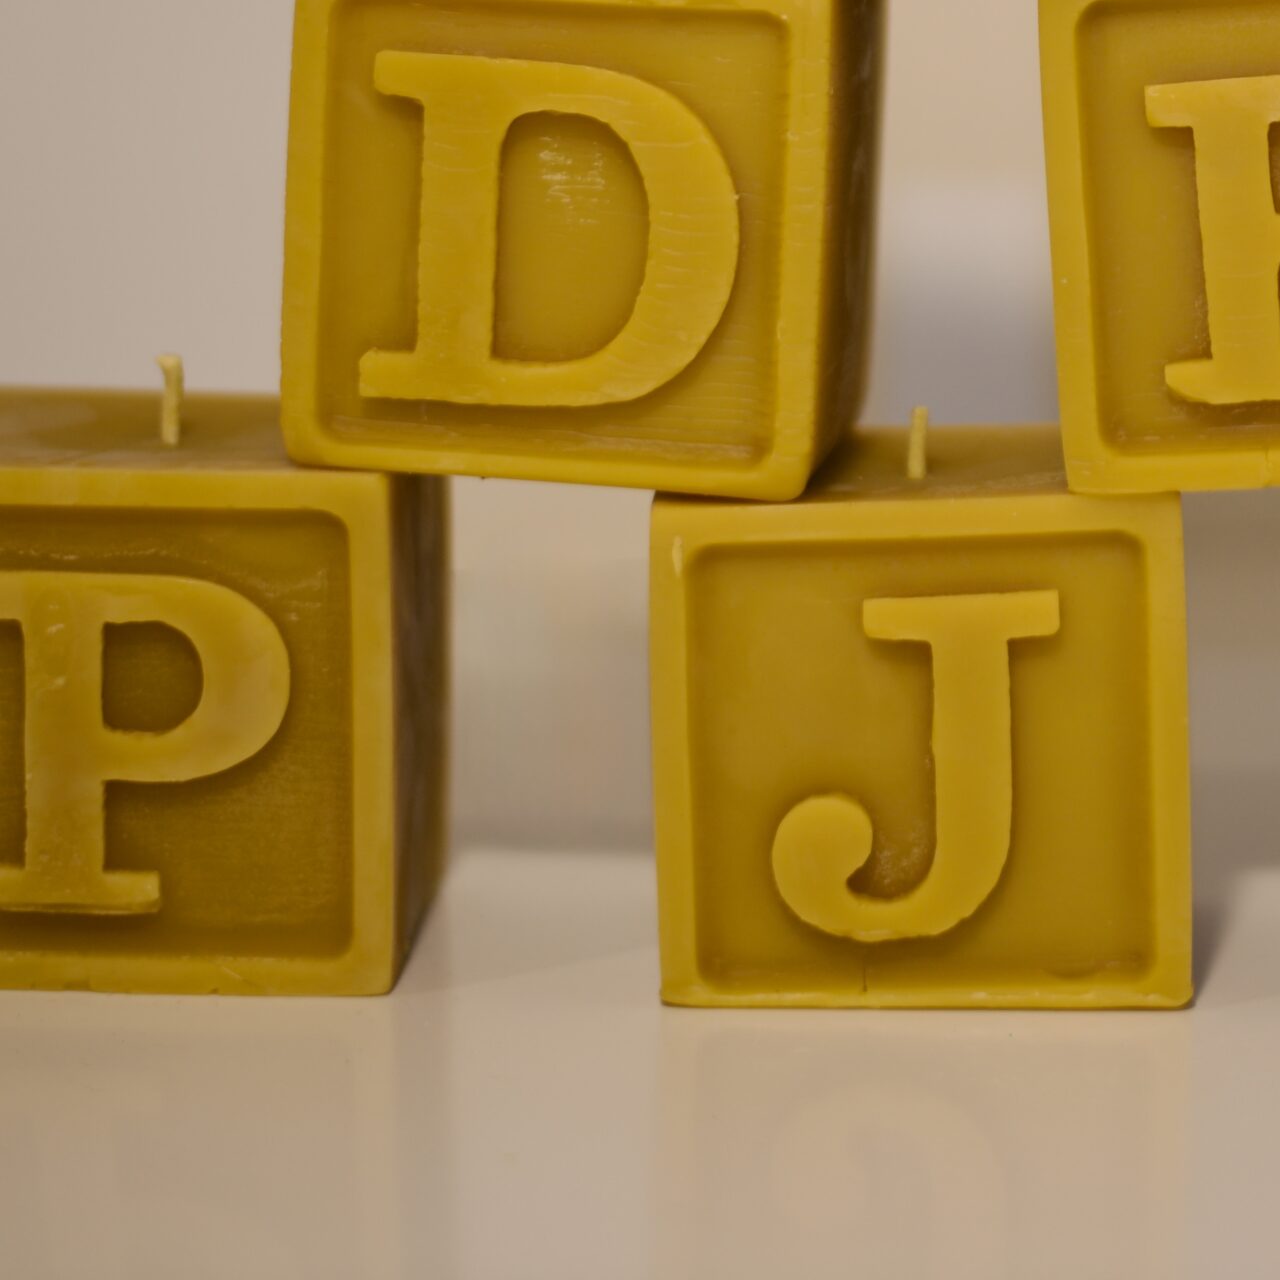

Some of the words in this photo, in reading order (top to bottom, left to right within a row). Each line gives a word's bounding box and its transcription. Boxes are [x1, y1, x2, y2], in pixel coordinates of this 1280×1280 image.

[357, 49, 740, 408] D
[0, 571, 291, 915] P
[772, 591, 1061, 943] J
